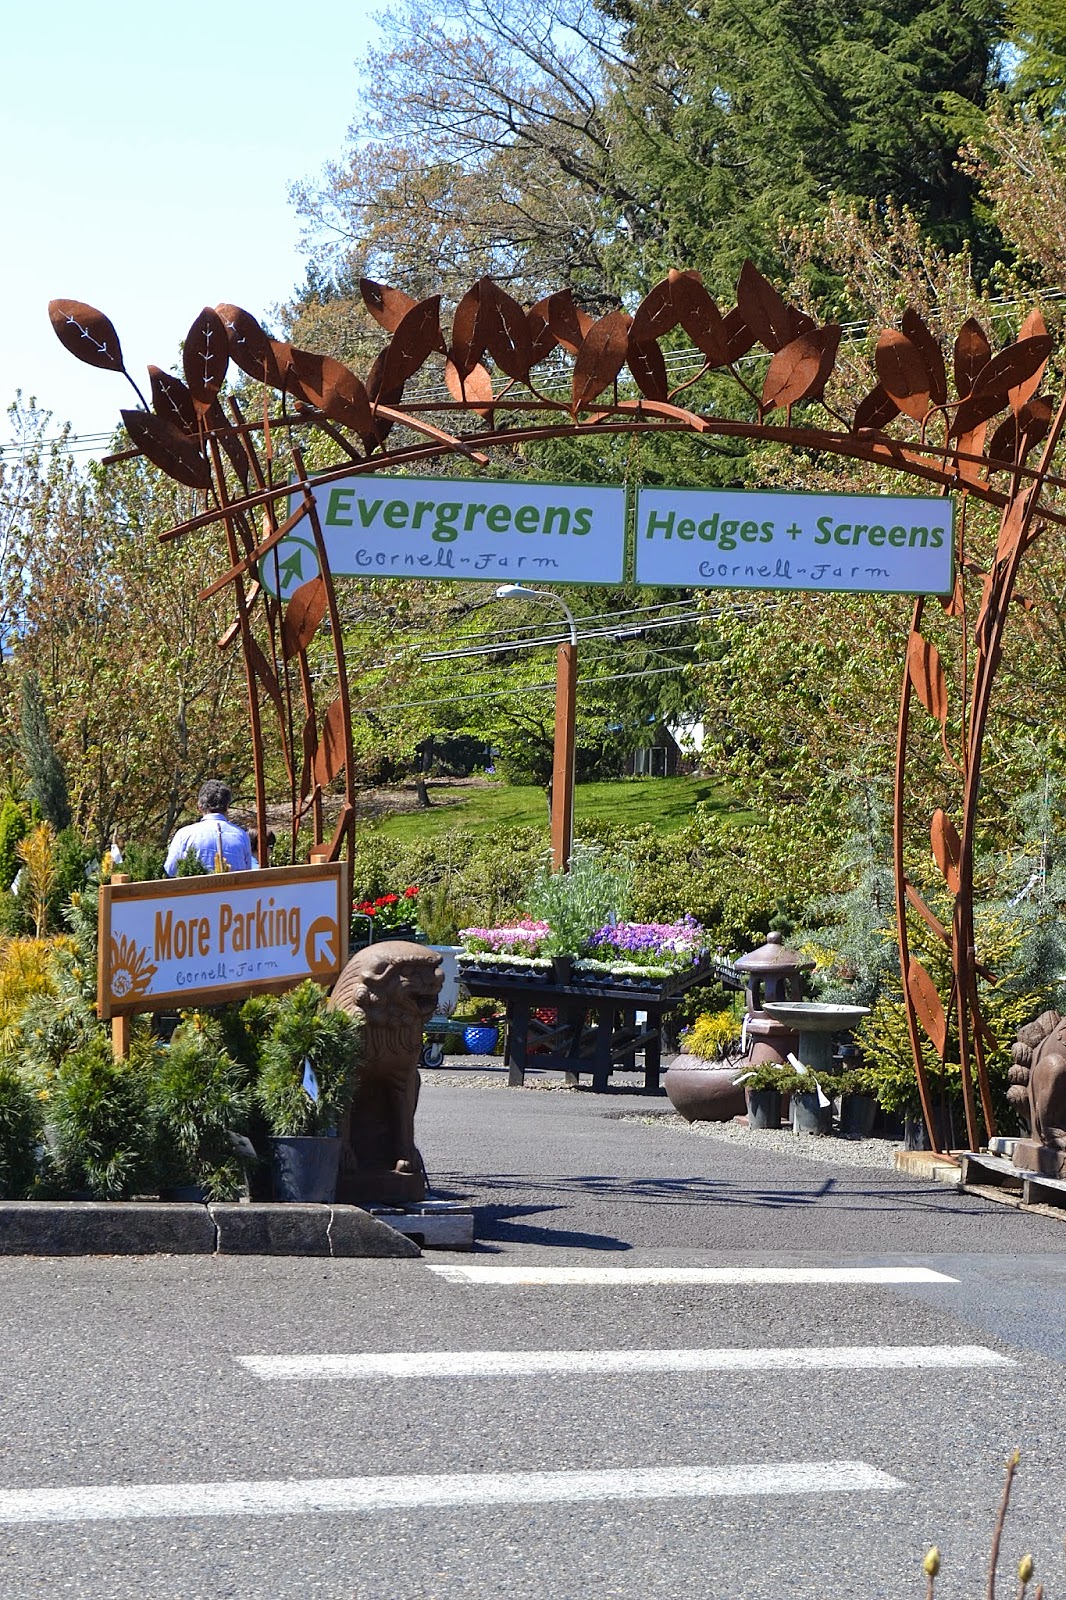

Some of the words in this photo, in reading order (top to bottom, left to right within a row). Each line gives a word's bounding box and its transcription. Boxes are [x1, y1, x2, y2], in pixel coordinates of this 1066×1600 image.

[325, 487, 594, 543] Evergreens
[645, 510, 775, 551] Hedges
[813, 516, 945, 548] Screens
[155, 911, 210, 961] More
[219, 897, 300, 956] Parking
